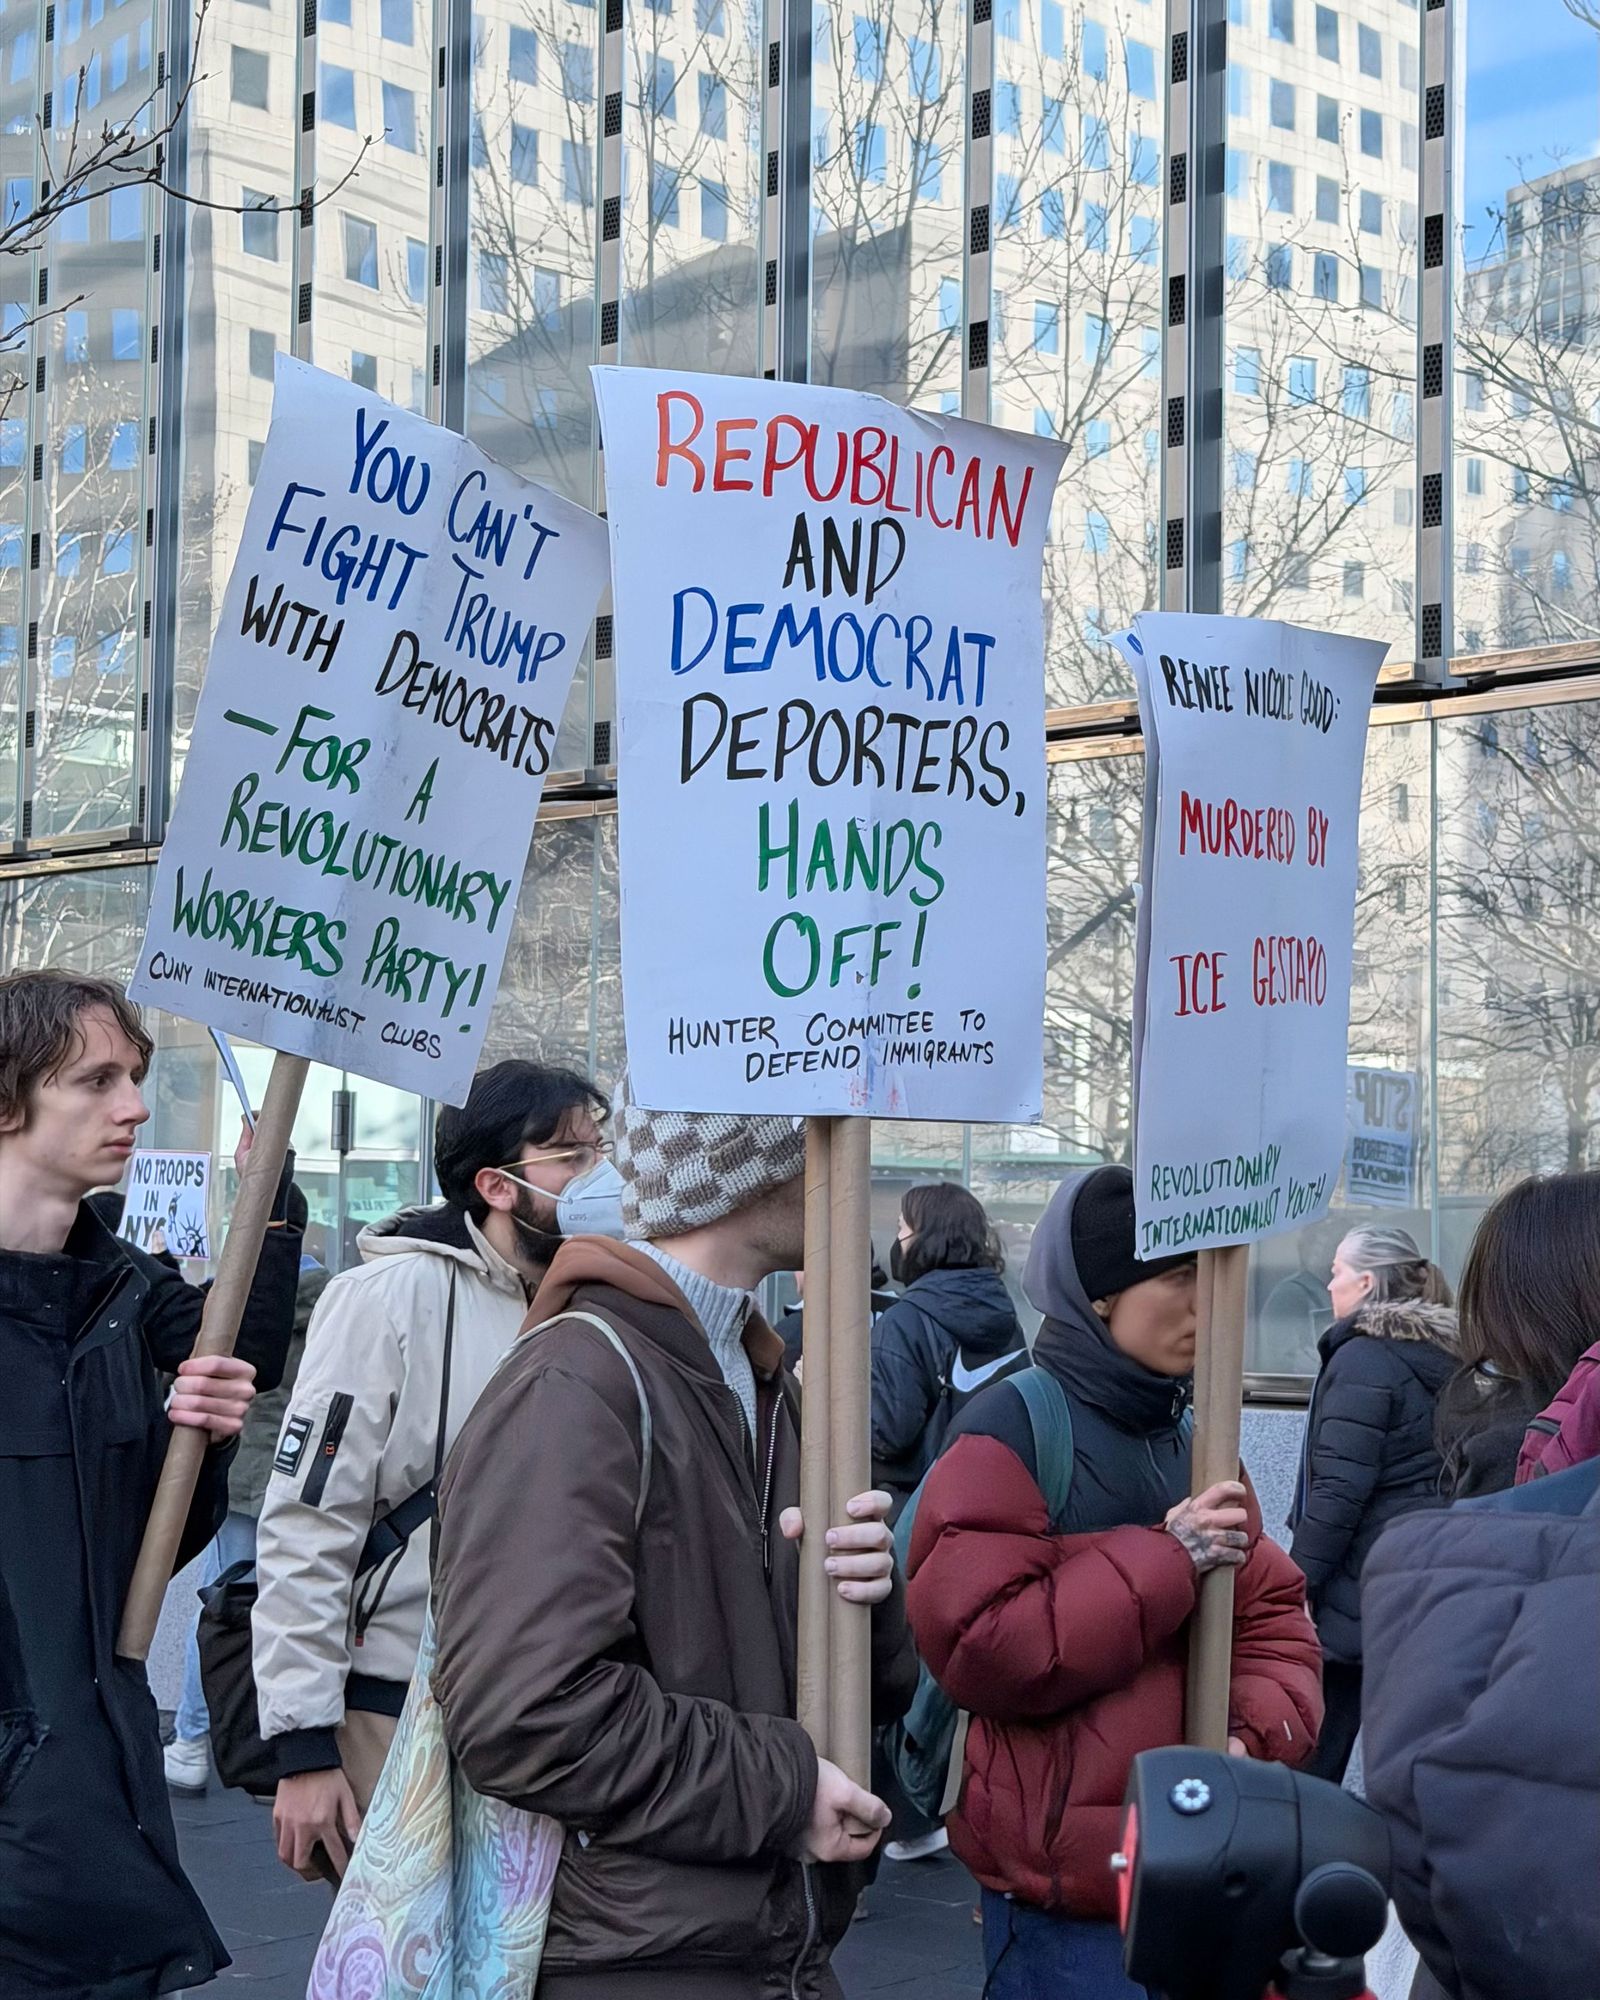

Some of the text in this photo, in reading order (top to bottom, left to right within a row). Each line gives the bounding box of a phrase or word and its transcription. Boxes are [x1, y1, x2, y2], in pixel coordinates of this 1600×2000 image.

[349, 407, 560, 580] YOU CAN'T
[656, 390, 1035, 548] REPUBLICAN
[266, 482, 566, 684] FIGHT TRUMP
[782, 511, 906, 606] AND
[240, 574, 555, 776] WITH DEMOCRATS
[670, 586, 996, 707] DEMOCRAT
[1159, 654, 1341, 734] RENEE NICOLE GOOD:
[404, 757, 440, 825] A
[681, 692, 1026, 817] DEPORTERS,
[220, 772, 512, 934] REVOLUTIONARY
[758, 798, 945, 906] HANDS
[1179, 790, 1329, 868] MURDERED BY
[172, 865, 487, 1034] WORKERS PARTY!
[762, 910, 928, 1000] OFF!
[1168, 935, 1327, 1017] ICE GESTAPO
[149, 951, 441, 1059] CUNY INTERNATIONALIST CLUBS
[668, 1009, 986, 1056] HUNTER COMMITTEE TO
[746, 1040, 994, 1084] DEFEND IMMIGRANTS
[133, 1158, 205, 1187] NO TROOPS
[144, 1190, 159, 1212] IN
[1142, 1173, 1327, 1253] INTERNATIONALIST YOUTH
[1151, 1143, 1282, 1202] REVOLUTIONARY
